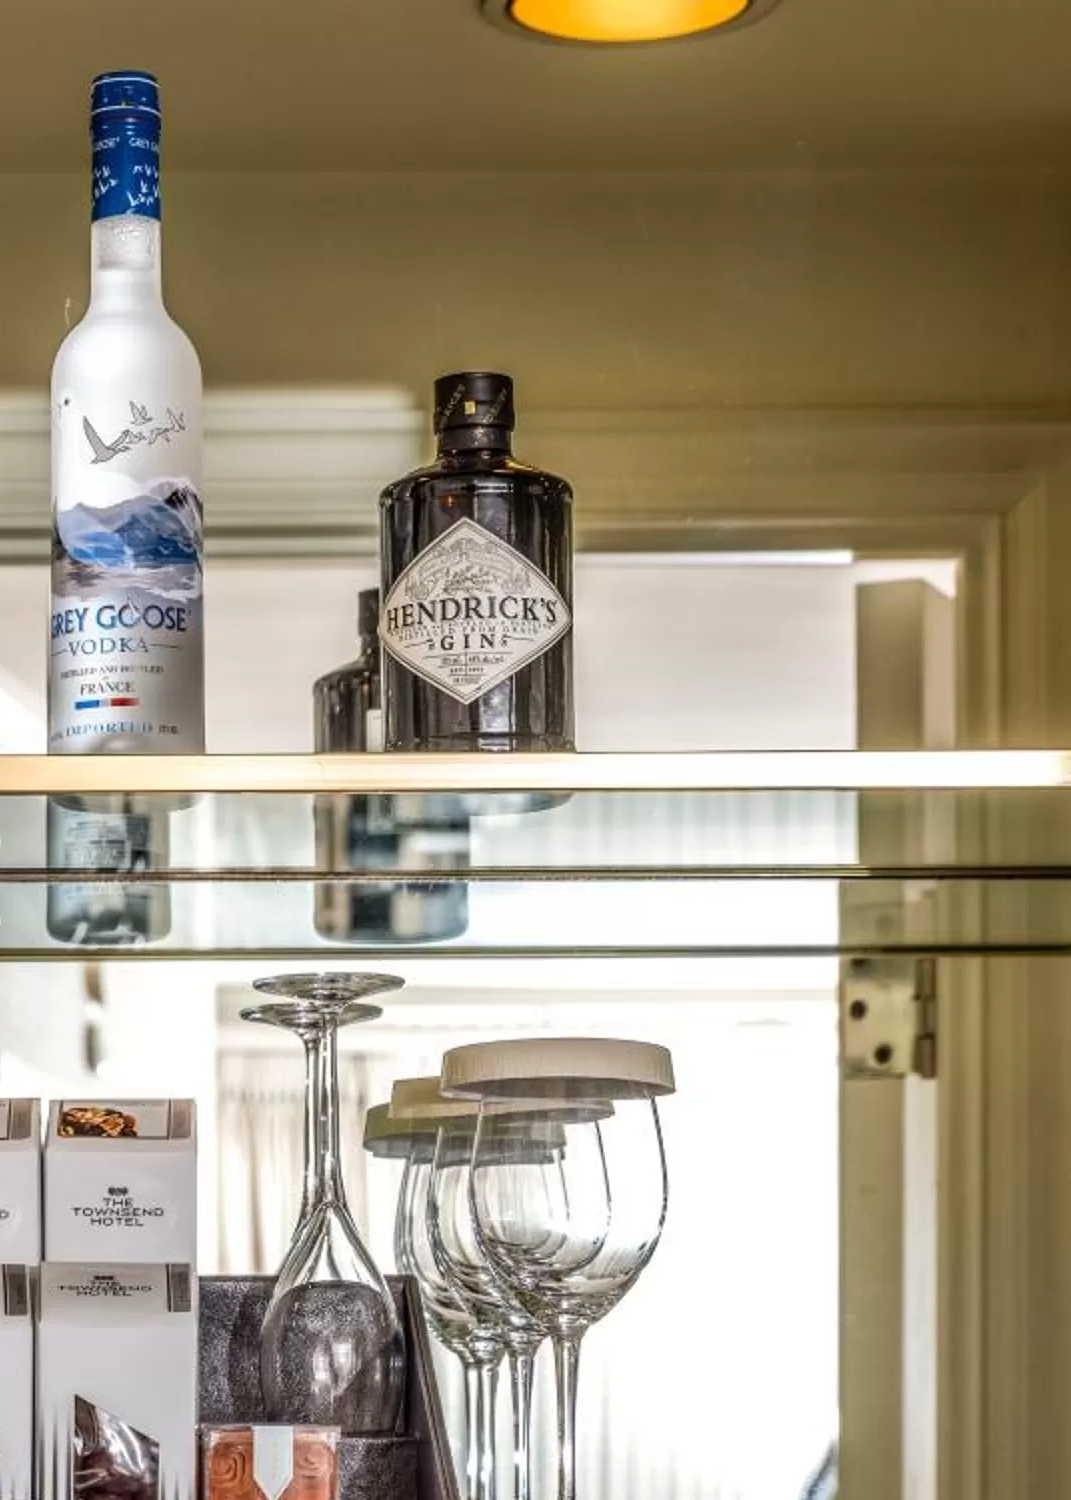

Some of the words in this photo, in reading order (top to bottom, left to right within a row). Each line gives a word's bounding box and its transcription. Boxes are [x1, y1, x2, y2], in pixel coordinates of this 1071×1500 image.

[96, 604, 187, 633] GOOSE
[387, 595, 558, 632] HENDRICK'S
[67, 637, 150, 657] VODKA
[440, 632, 497, 651] GIN
[79, 680, 136, 696] FRANCE
[102, 1197, 134, 1207] THE
[72, 1206, 165, 1217] TOWNSEND
[89, 1217, 145, 1227] HOTEL
